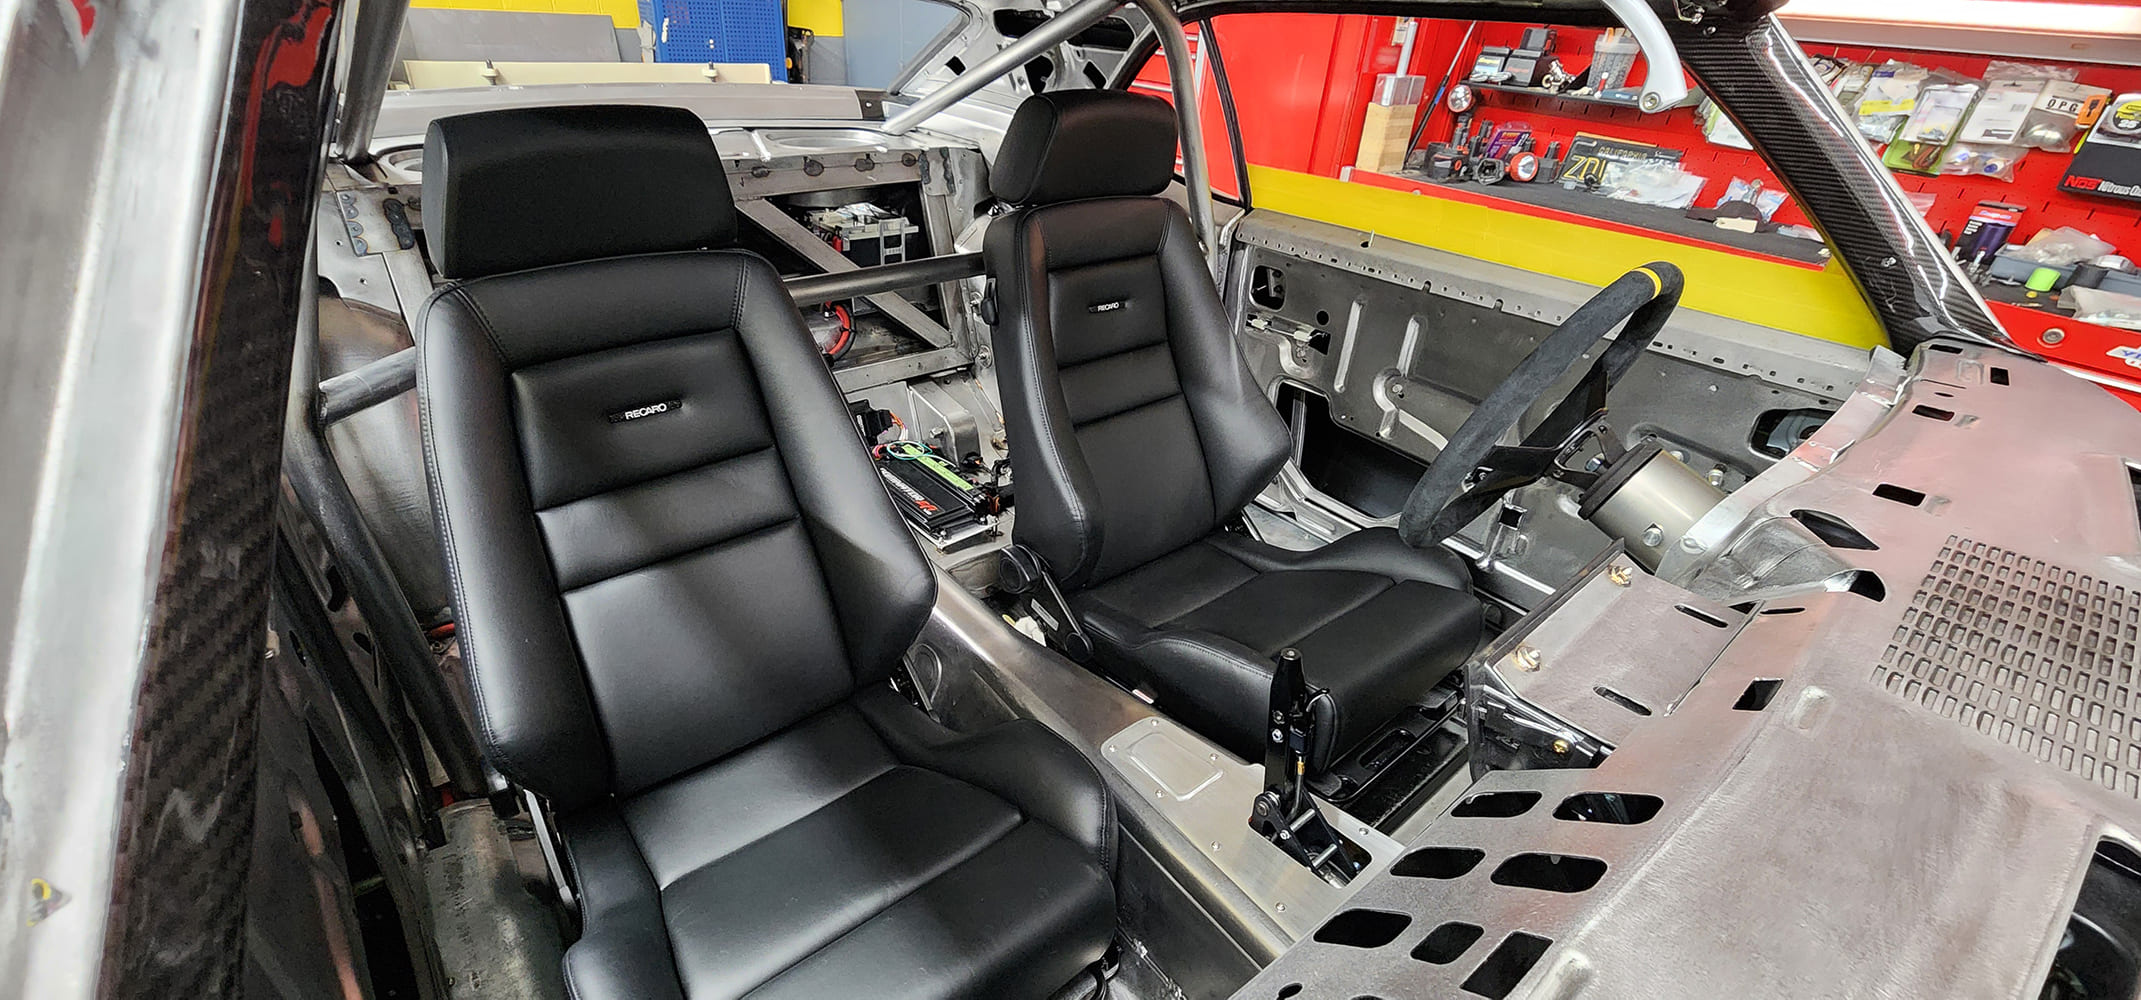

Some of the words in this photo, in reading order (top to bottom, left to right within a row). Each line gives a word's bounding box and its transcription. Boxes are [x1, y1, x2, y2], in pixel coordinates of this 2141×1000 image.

[2047, 98, 2079, 112] OPG
[1097, 301, 1120, 312] RECARO
[624, 403, 668, 420] RECARO
